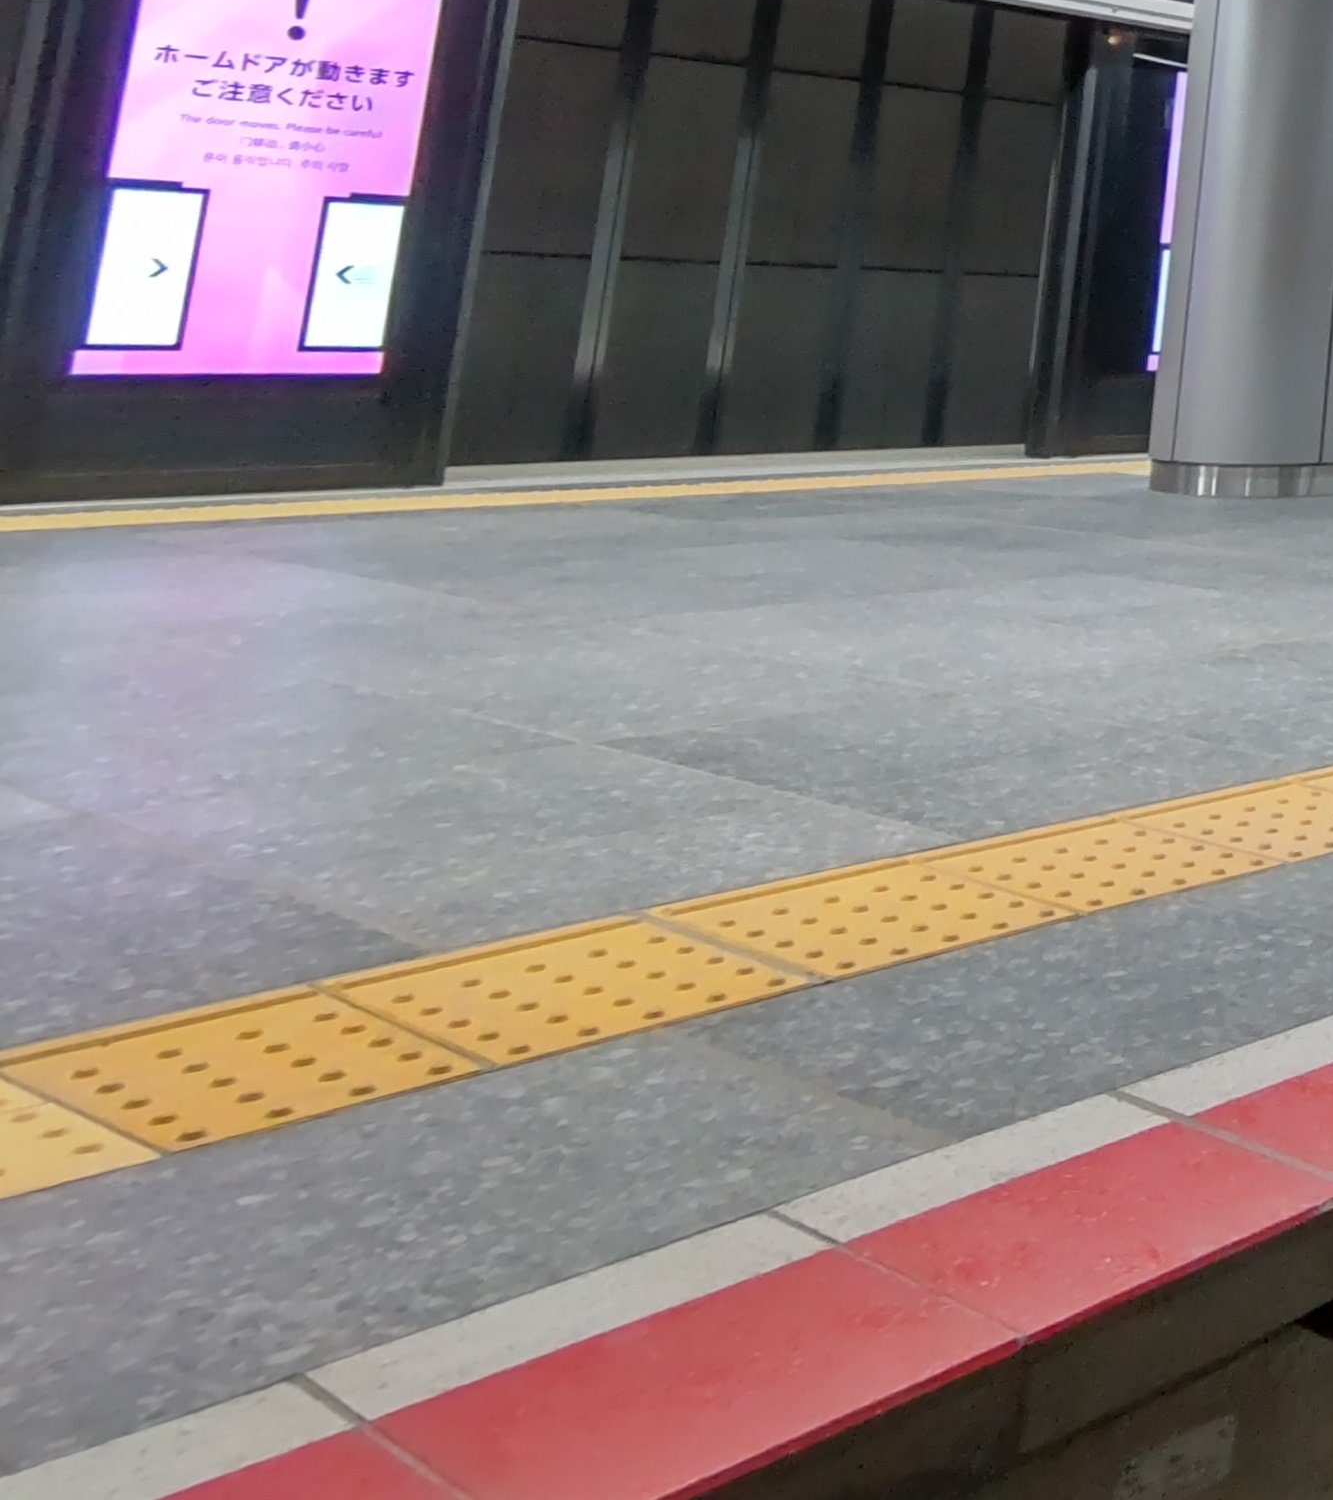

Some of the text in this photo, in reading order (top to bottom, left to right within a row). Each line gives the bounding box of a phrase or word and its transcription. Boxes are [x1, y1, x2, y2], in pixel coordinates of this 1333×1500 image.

[154, 44, 415, 88] ホームドアが動きます
[191, 79, 374, 112] ご注意ください
